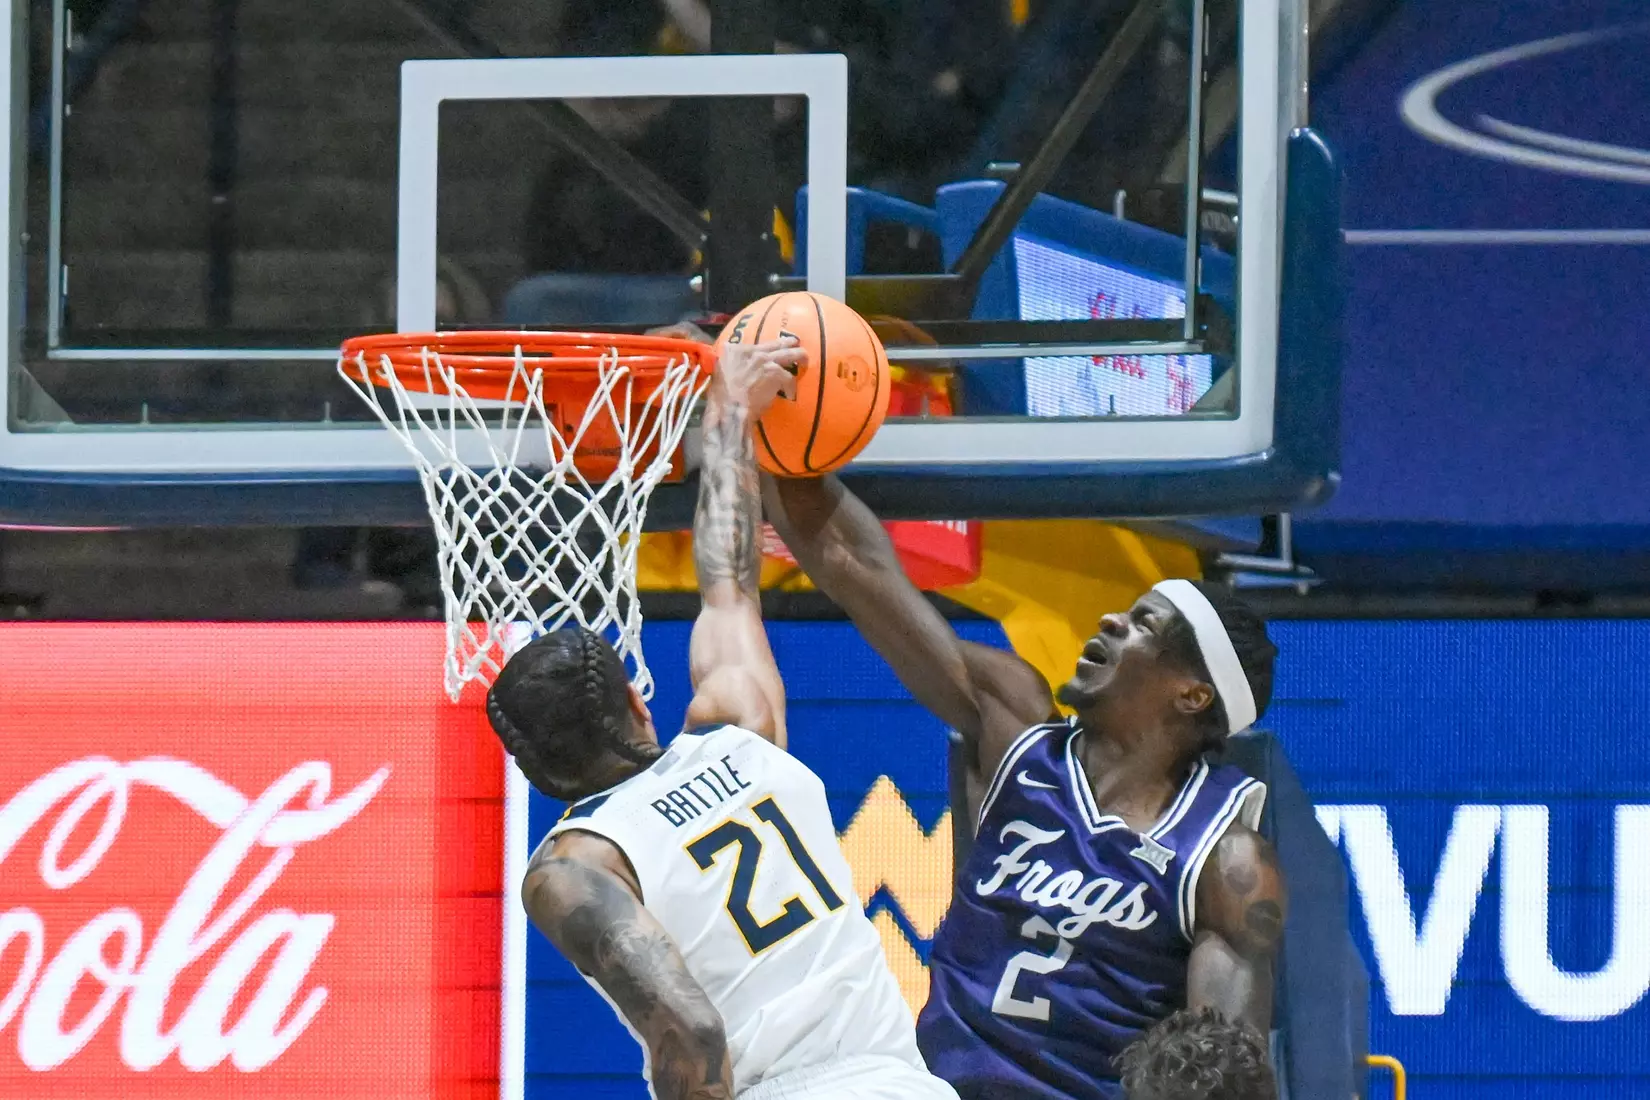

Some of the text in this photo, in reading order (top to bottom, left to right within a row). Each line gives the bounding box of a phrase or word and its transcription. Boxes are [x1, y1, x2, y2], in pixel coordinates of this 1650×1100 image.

[651, 755, 752, 827] BATTLE
[683, 794, 846, 958] 21
[976, 820, 1158, 938] Frogs
[1313, 804, 1650, 1022] VU
[991, 914, 1075, 1021] 2
